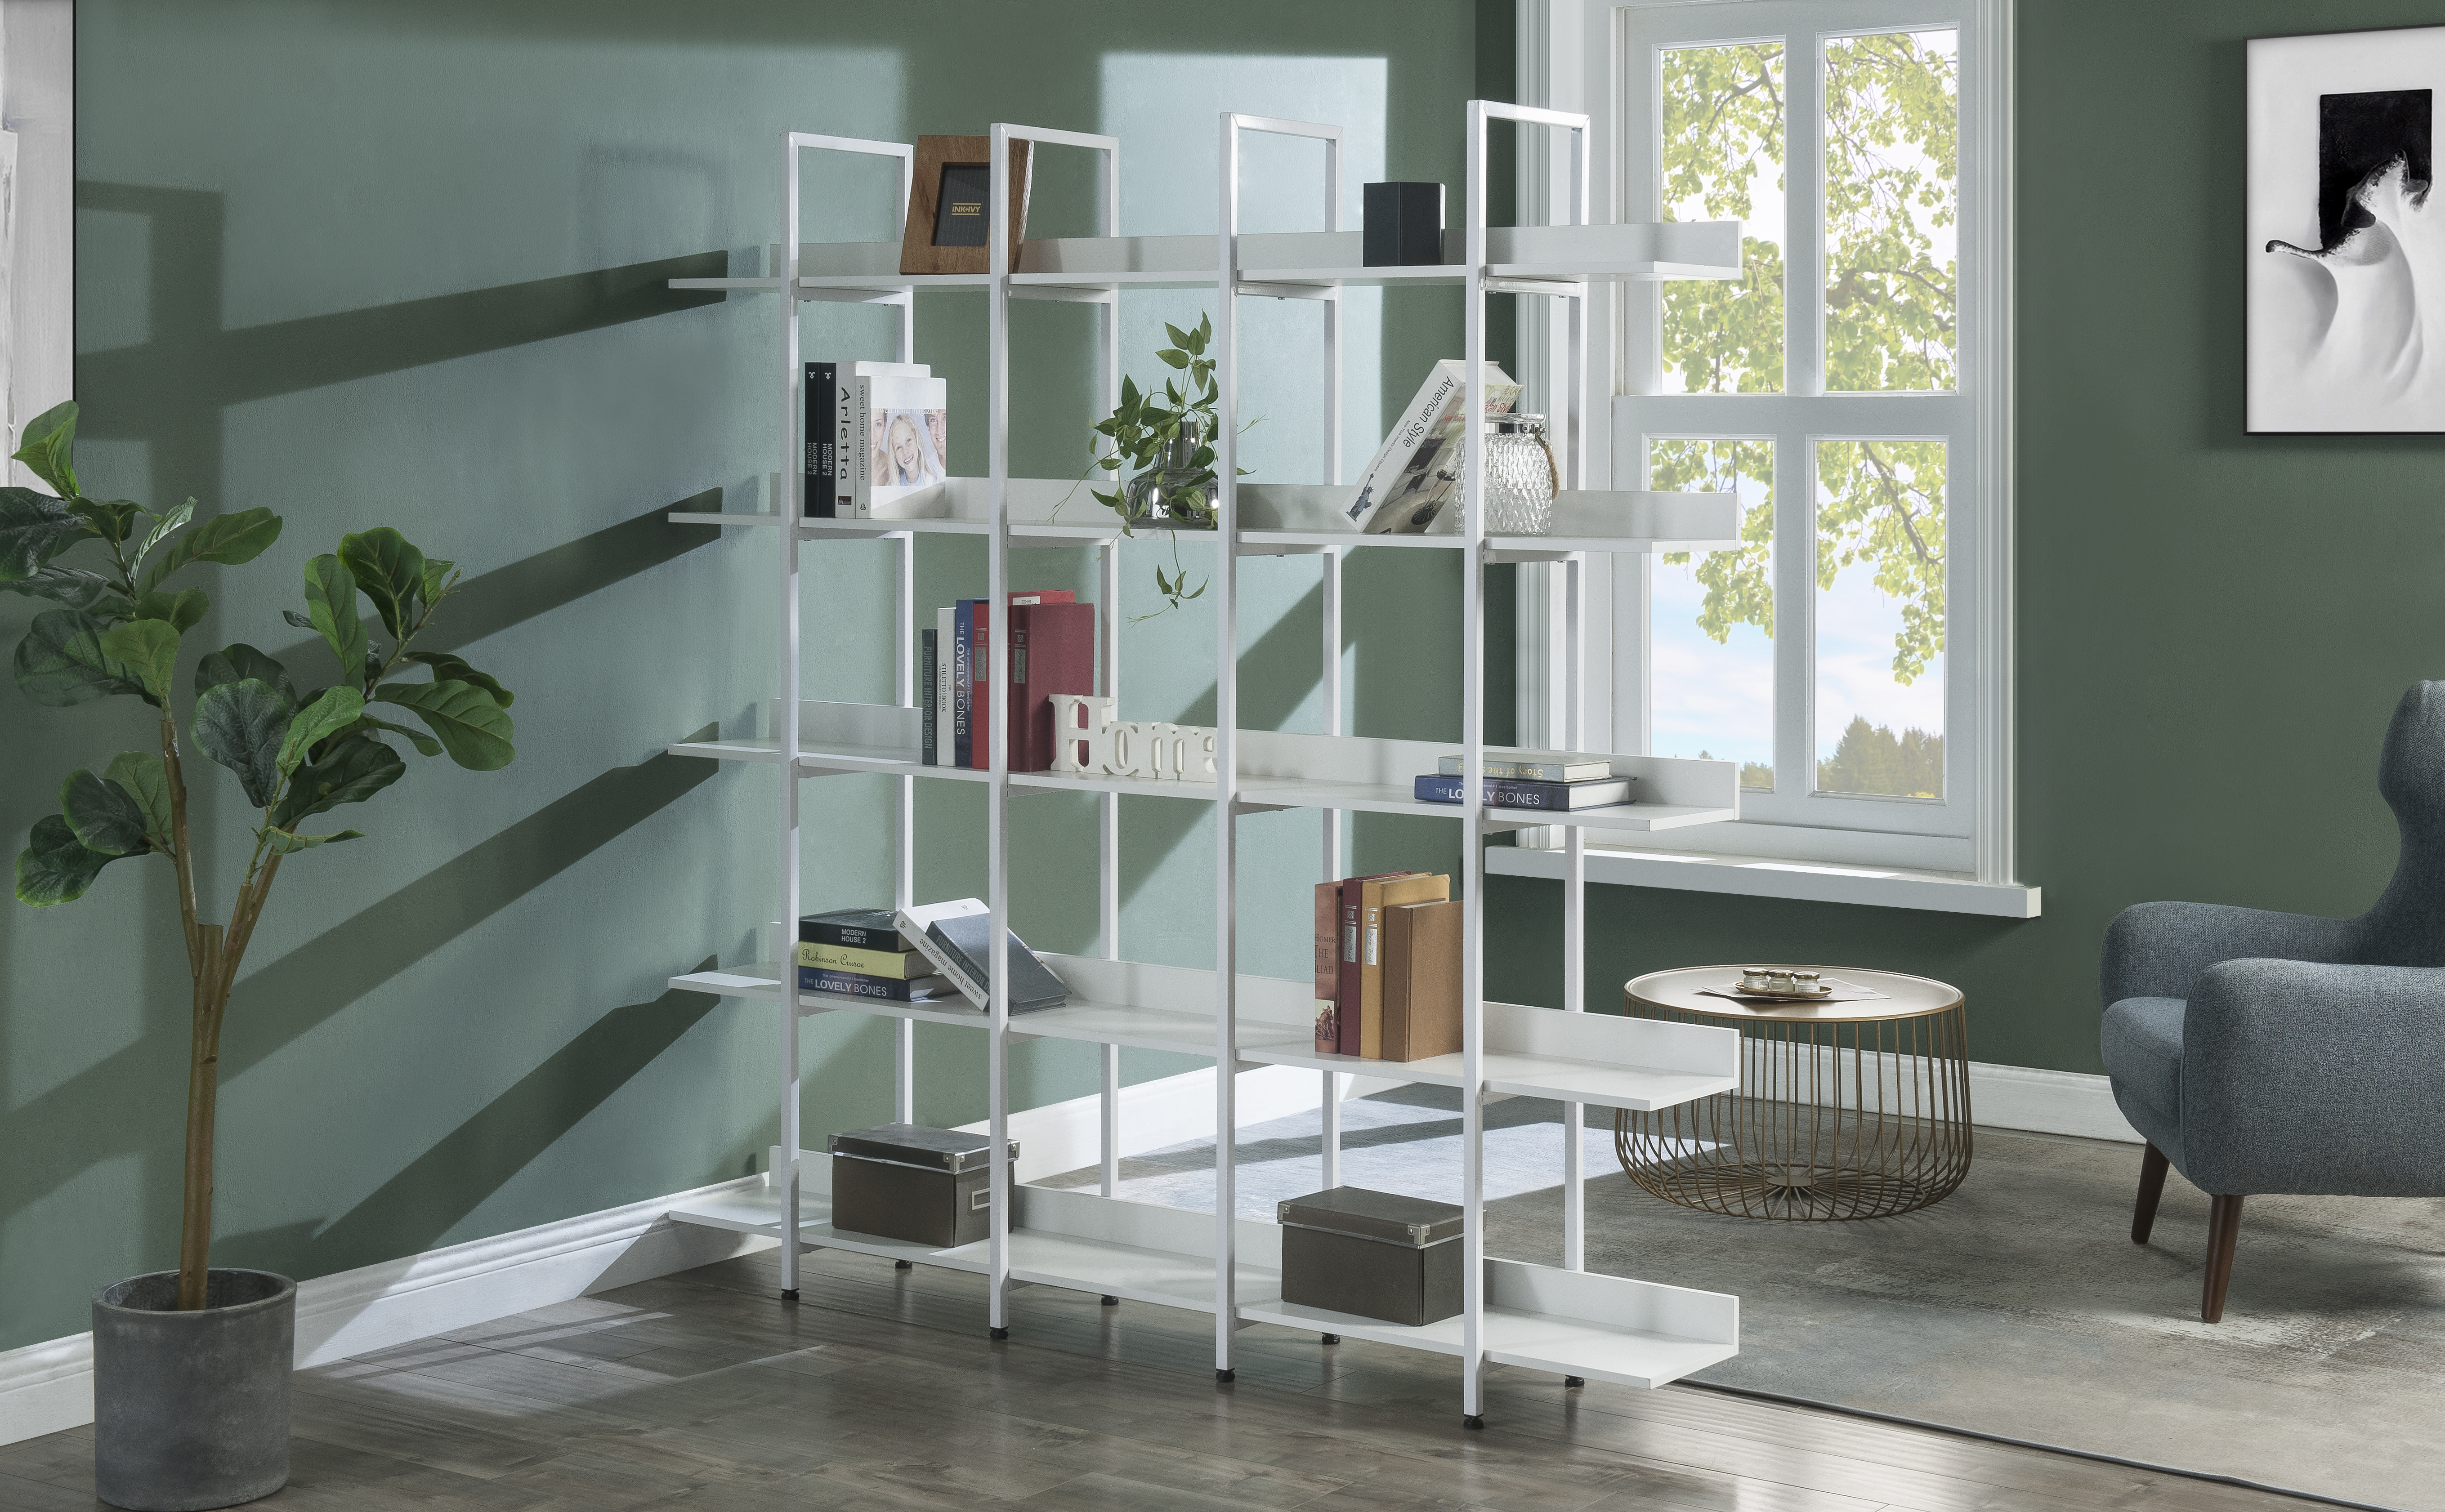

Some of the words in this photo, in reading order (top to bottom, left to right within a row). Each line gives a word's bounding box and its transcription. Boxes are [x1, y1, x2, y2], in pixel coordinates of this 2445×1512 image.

[1419, 376, 1454, 423] American
[840, 387, 851, 480] Arletta
[1390, 435, 1399, 448] Interior
[1403, 423, 1424, 448] Style
[1383, 447, 1392, 459] Design
[1374, 459, 1384, 472] Opuses
[924, 647, 932, 686] FURNITURE
[957, 637, 965, 687] LOVELY
[924, 687, 932, 720] INTERIOR
[957, 691, 965, 735] BONES
[924, 723, 932, 749] DESIGN
[1049, 694, 1217, 782] Home
[1488, 766, 1503, 776] the
[1506, 767, 1515, 776] of
[1518, 766, 1544, 778] Story
[1498, 792, 1540, 805] BONES
[841, 928, 866, 937] MODERN
[802, 949, 837, 964] Robinson
[840, 954, 865, 968] Crusoe
[919, 938, 948, 967] magazine
[936, 934, 964, 965] FURNITURE
[961, 960, 985, 987] INTERIOR
[948, 965, 965, 985] home
[815, 979, 852, 992] LOVELY
[854, 983, 887, 996] BONES
[964, 982, 982, 1000] sweet
